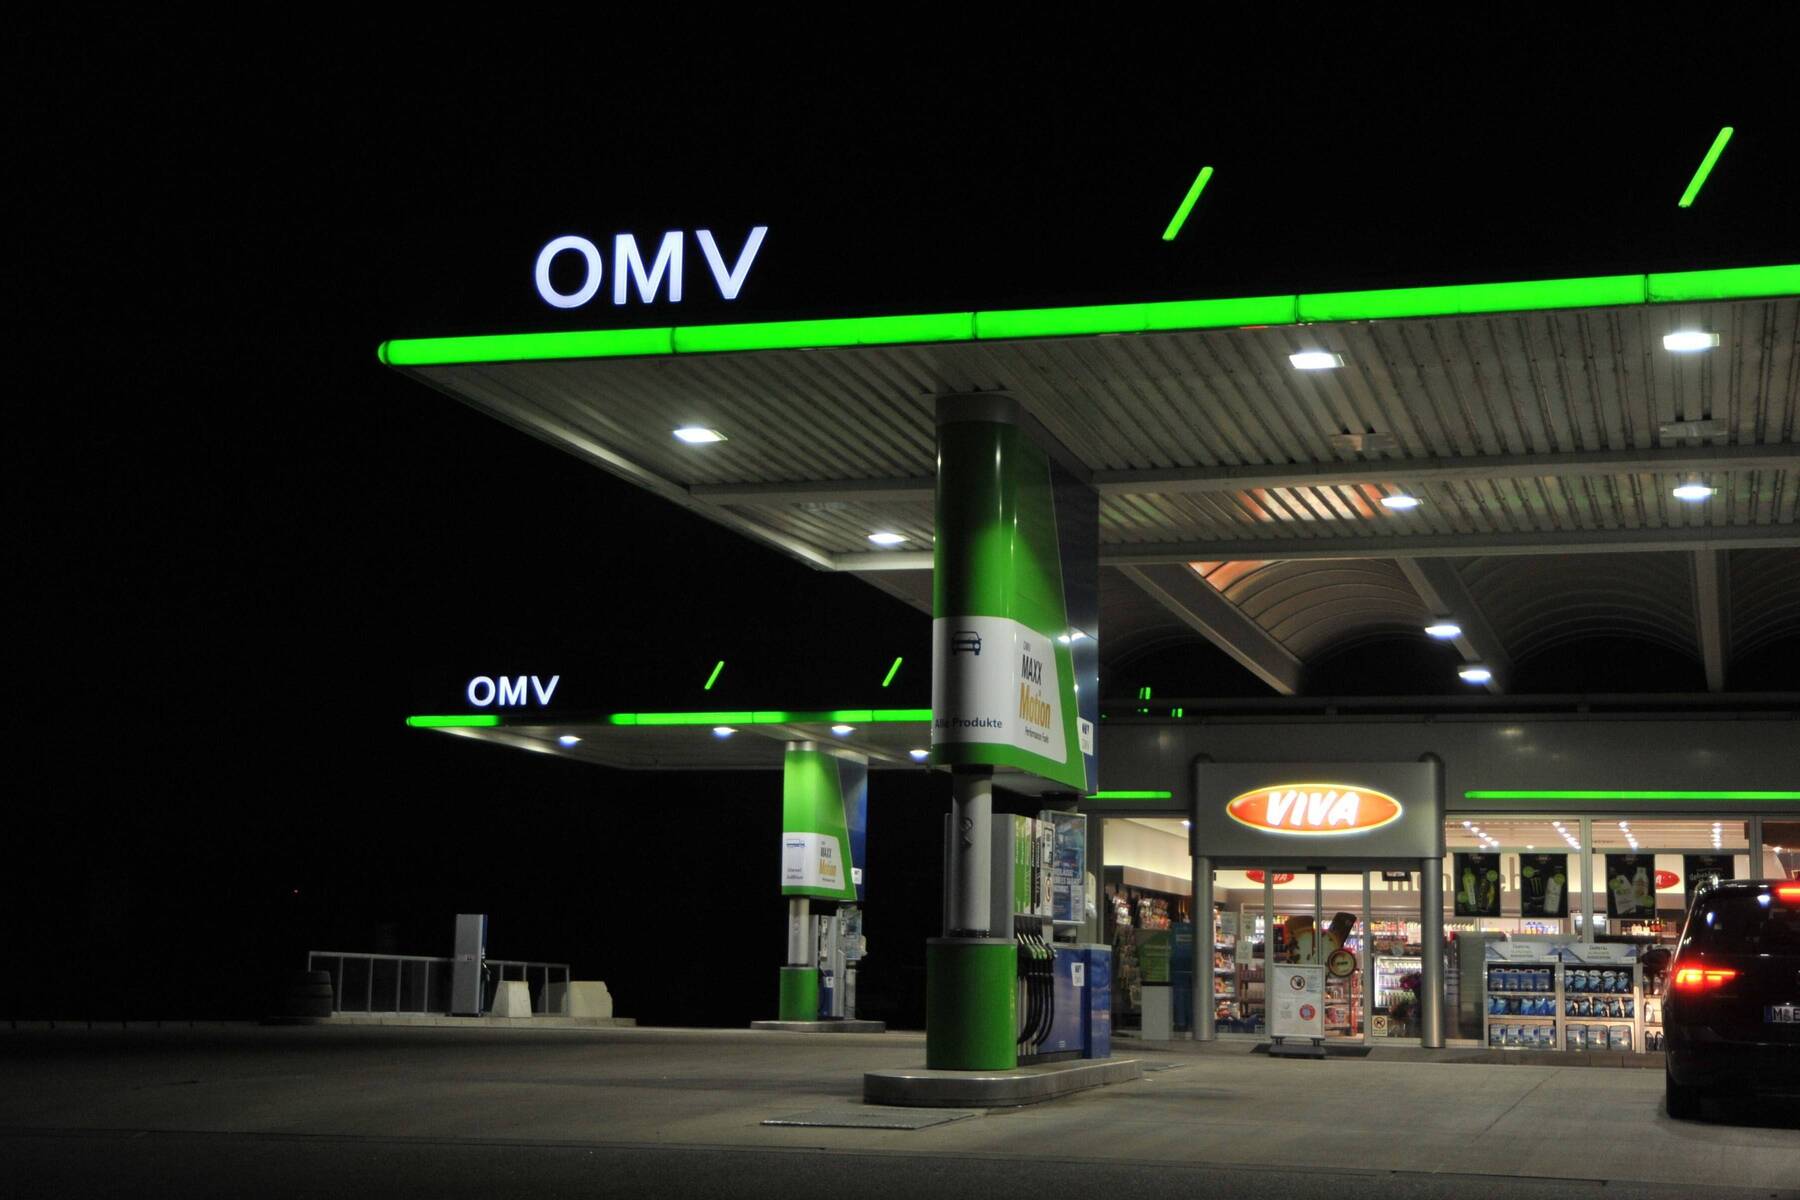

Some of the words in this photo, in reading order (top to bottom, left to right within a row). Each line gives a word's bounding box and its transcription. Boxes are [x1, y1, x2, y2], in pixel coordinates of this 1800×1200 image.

[535, 226, 768, 309] OMV
[1021, 653, 1043, 686] MAXX
[468, 675, 560, 707] OMV
[1019, 682, 1051, 730] Motion
[952, 717, 1003, 728] Produkte
[1266, 789, 1361, 826] VIVA
